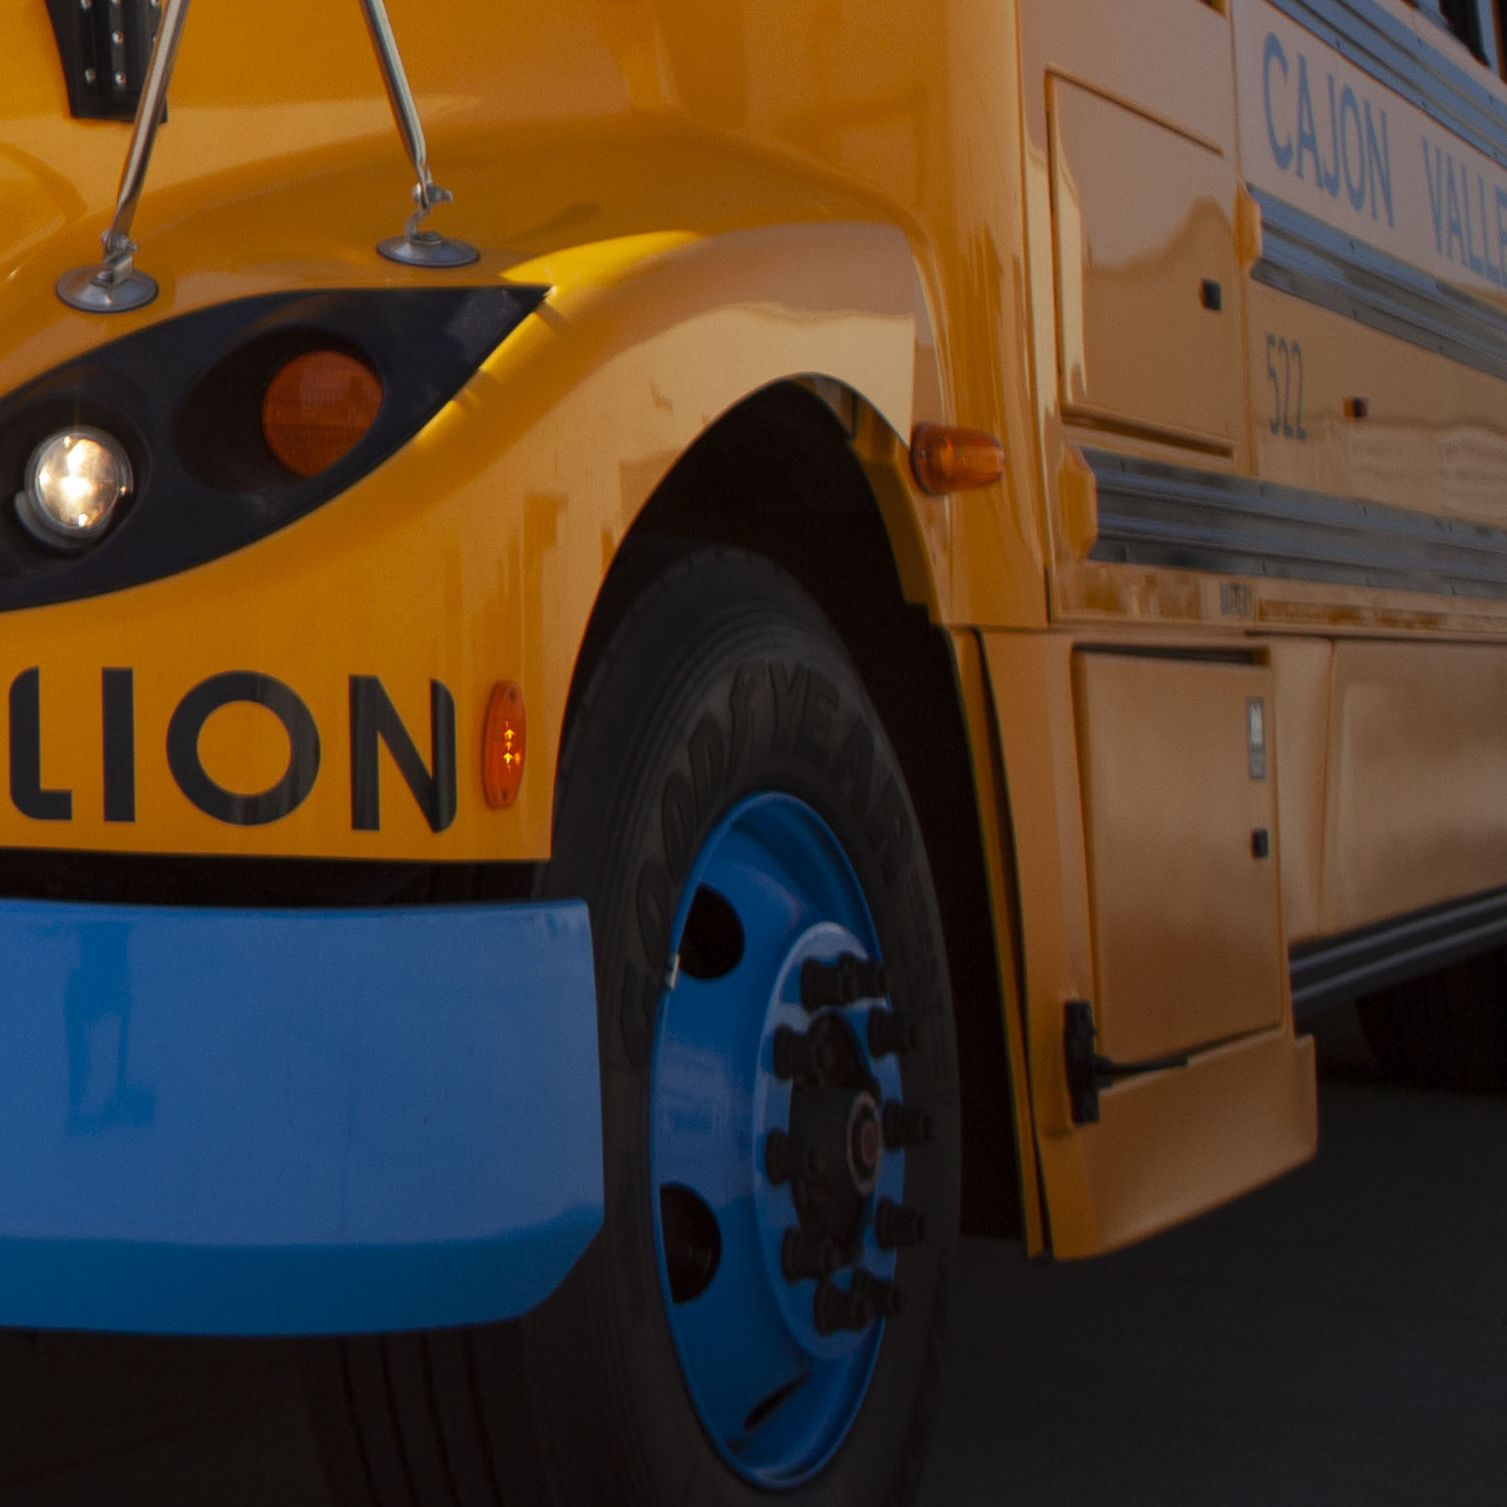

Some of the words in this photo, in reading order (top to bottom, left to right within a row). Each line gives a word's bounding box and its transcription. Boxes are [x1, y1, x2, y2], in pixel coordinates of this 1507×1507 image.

[1261, 32, 1396, 229] CAJON
[1265, 333, 1308, 442] 522
[8, 665, 458, 834] LION
